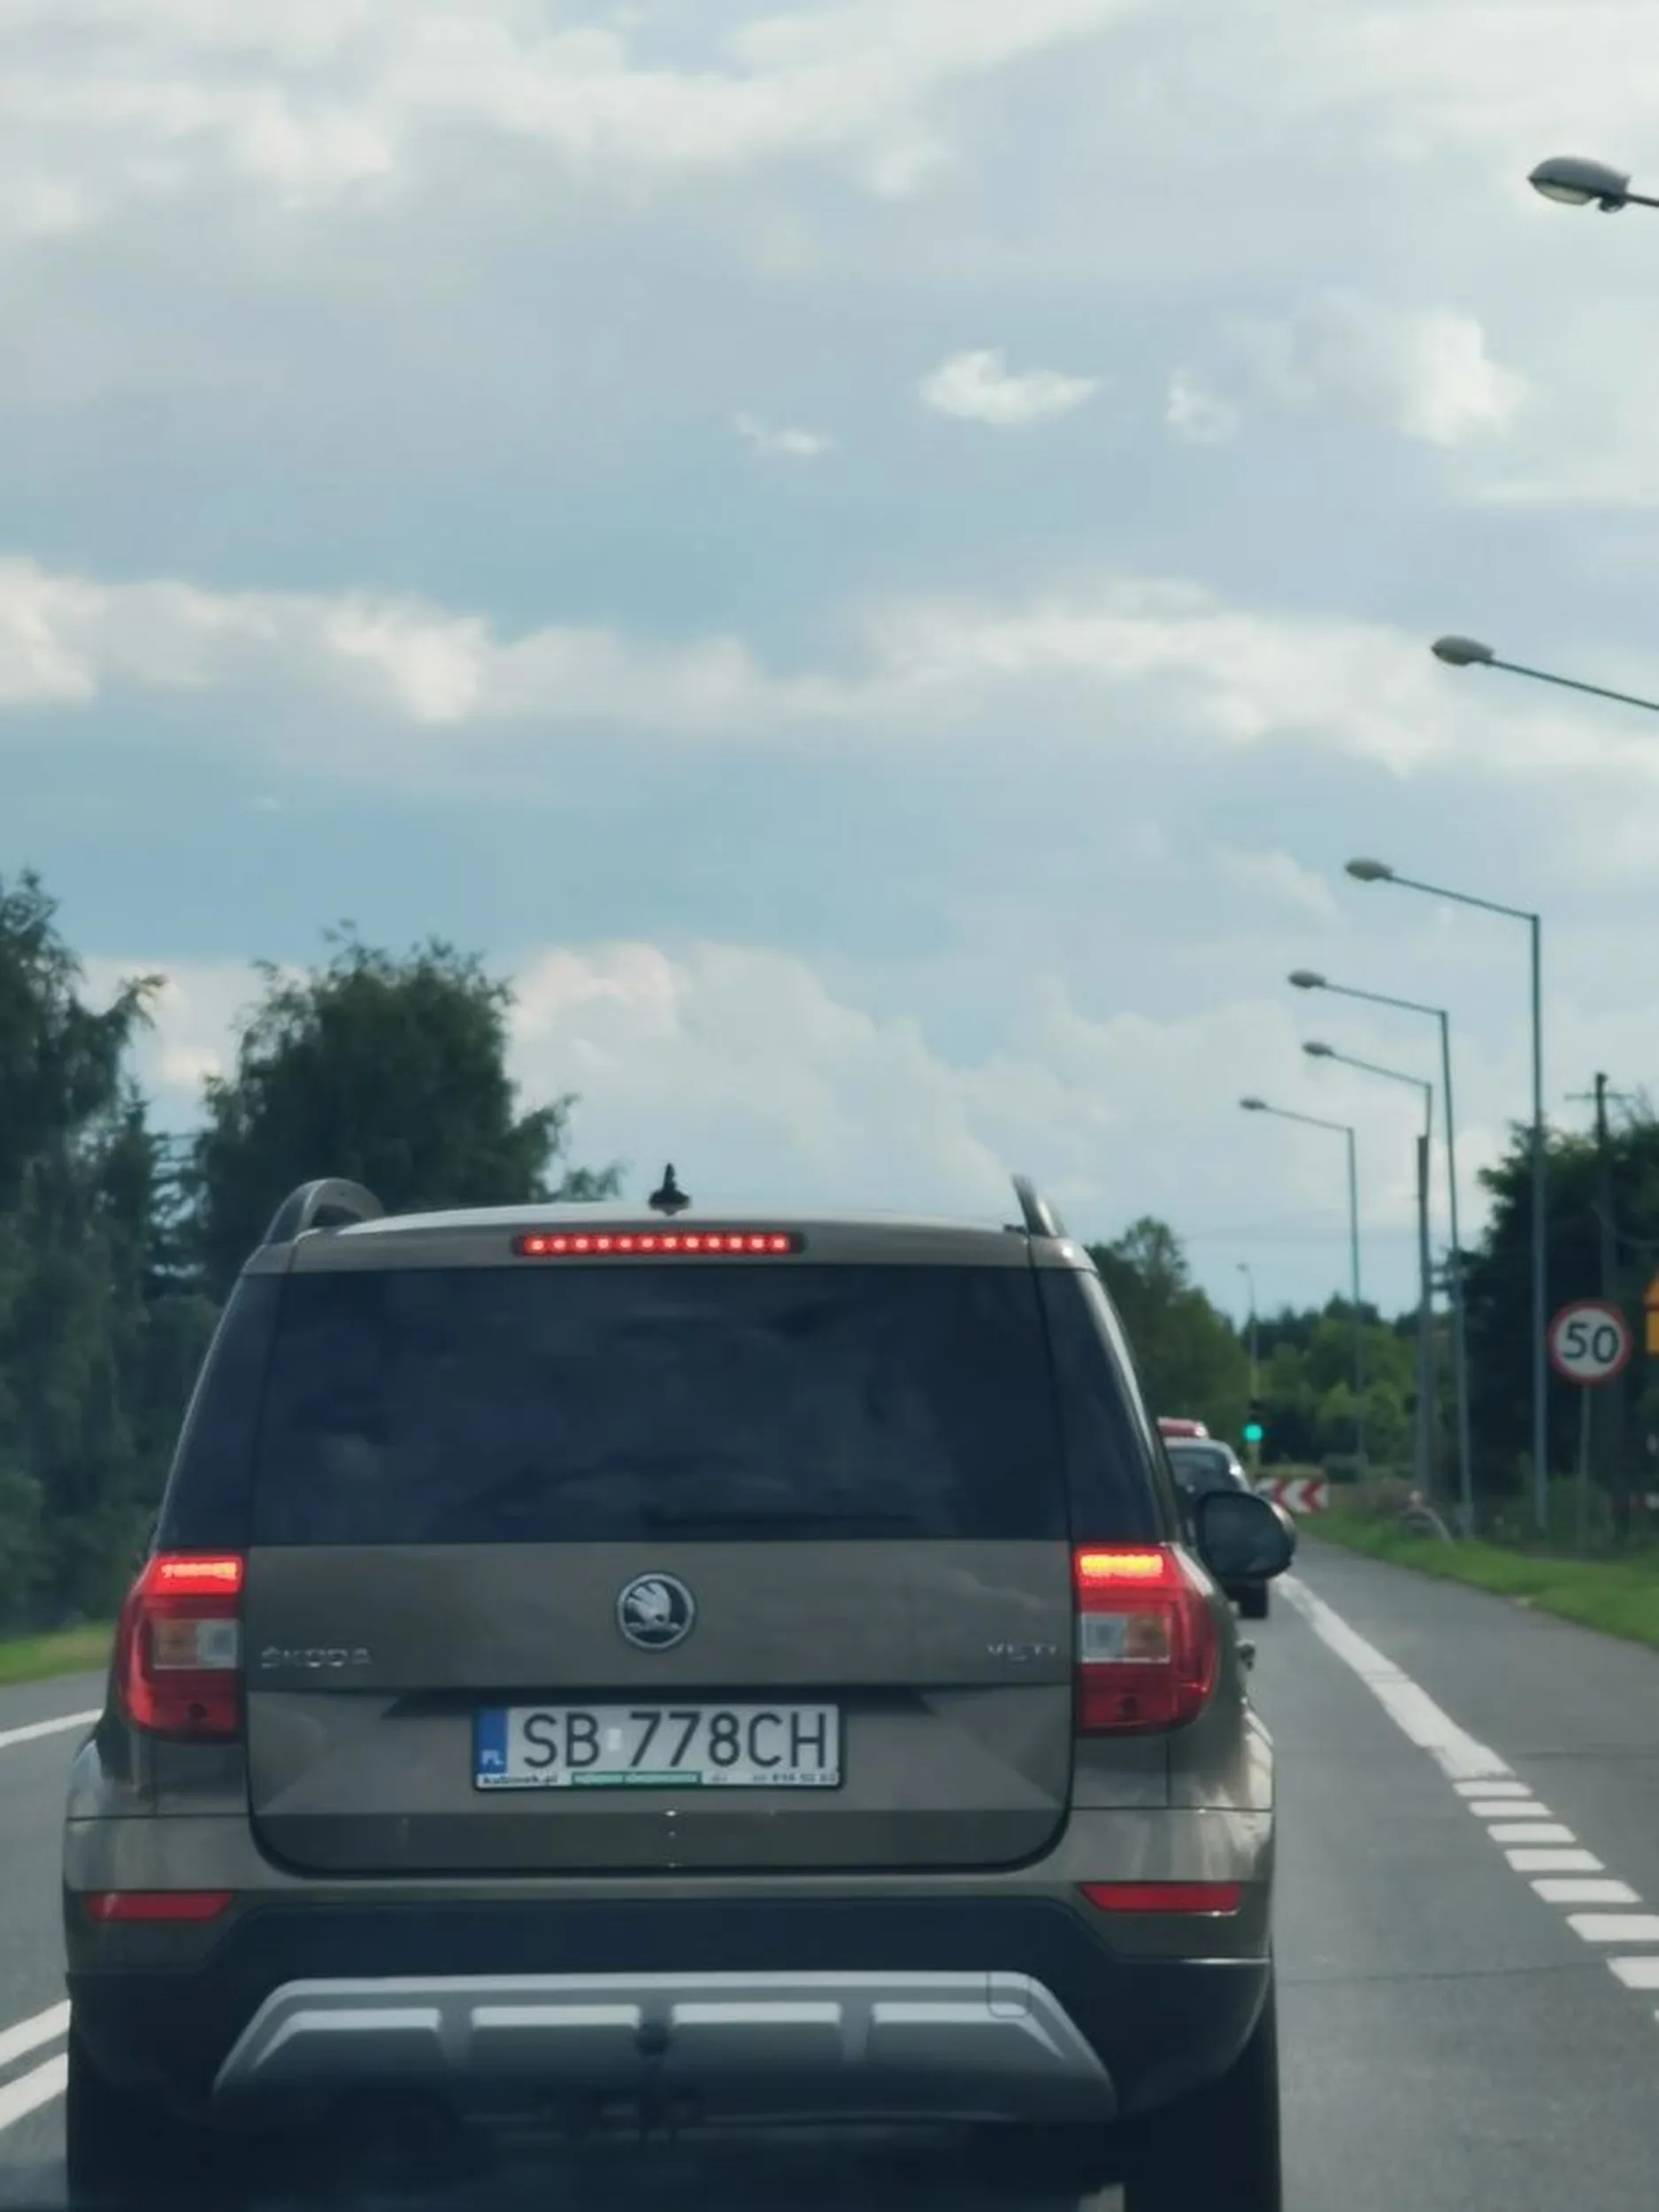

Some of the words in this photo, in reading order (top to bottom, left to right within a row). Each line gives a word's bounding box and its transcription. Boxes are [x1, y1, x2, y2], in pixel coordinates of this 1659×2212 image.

[1563, 1321, 1619, 1364] 50
[523, 1713, 601, 1768] SB
[629, 1710, 826, 1768] 778CH
